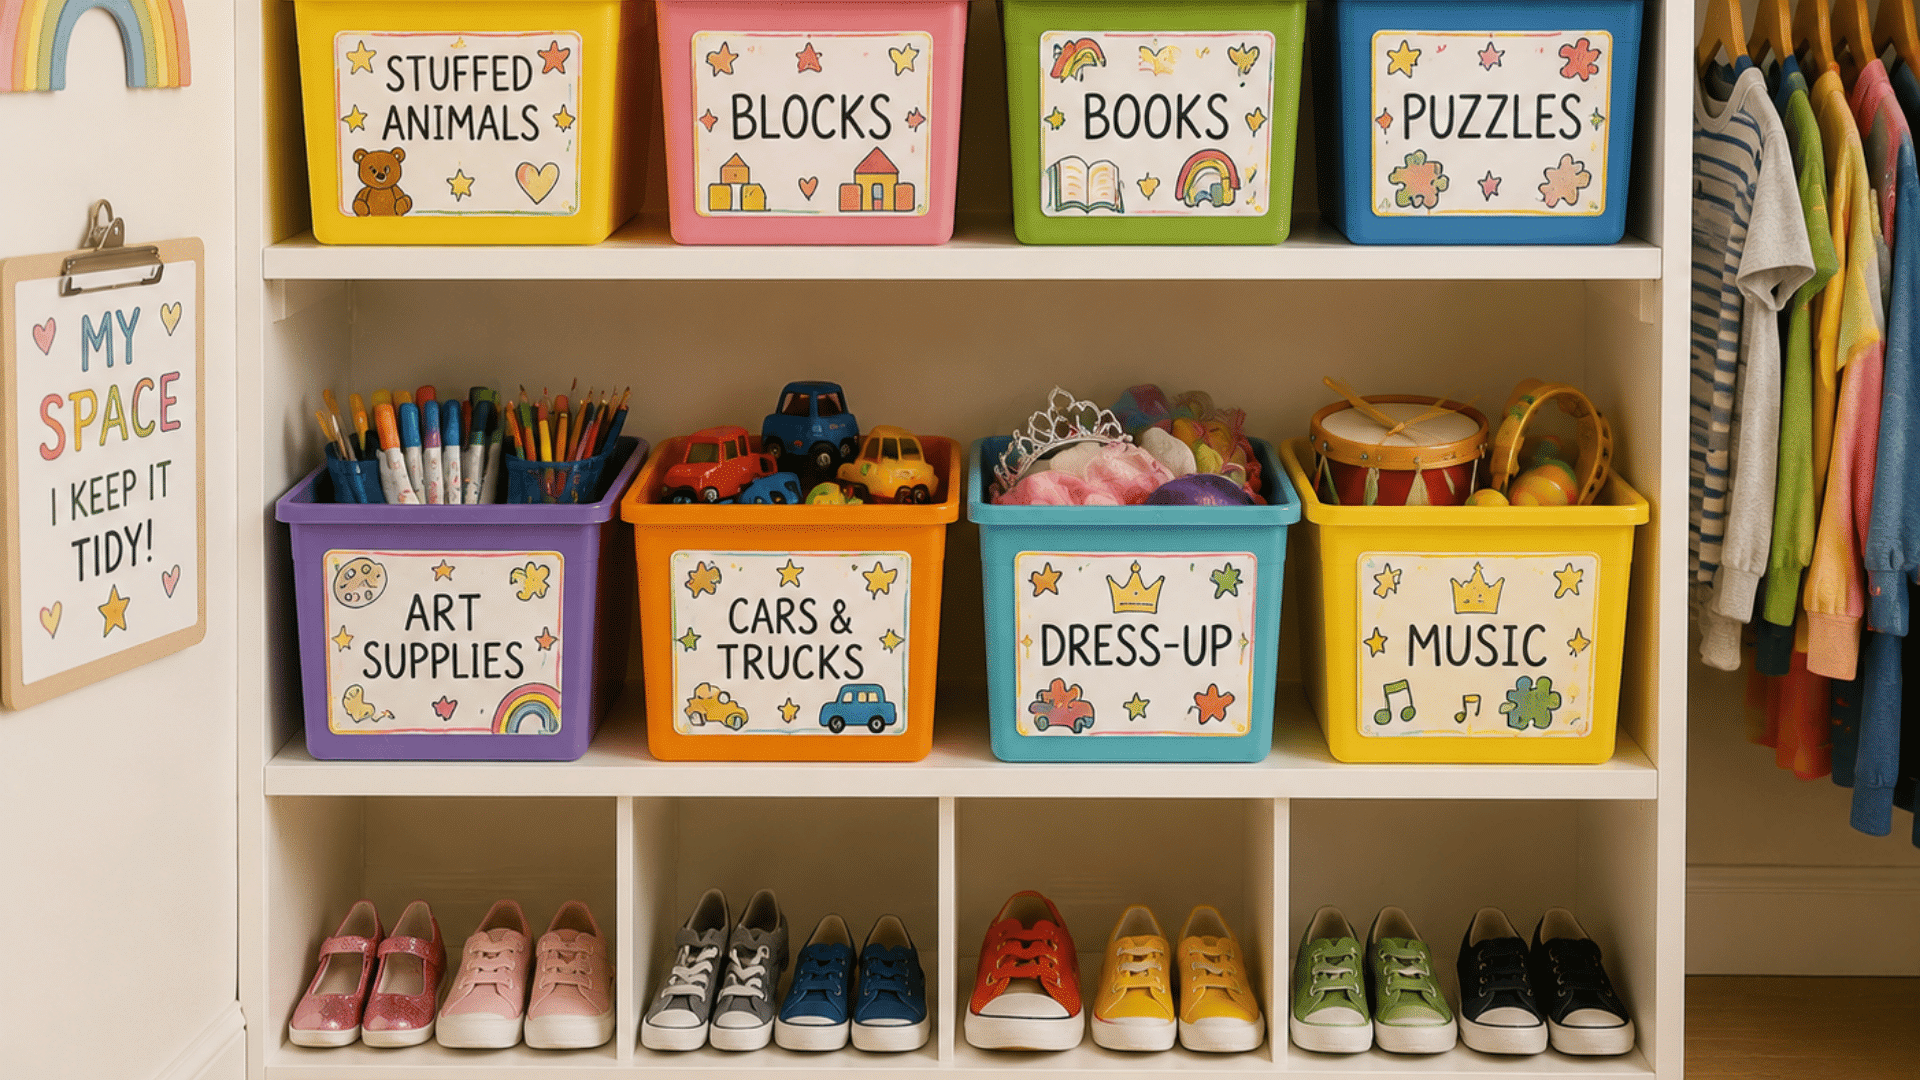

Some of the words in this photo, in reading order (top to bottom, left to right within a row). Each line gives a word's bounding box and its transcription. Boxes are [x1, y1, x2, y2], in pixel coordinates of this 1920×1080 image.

[386, 55, 533, 92] STUFFED
[381, 104, 540, 142] ANIMALS
[731, 93, 892, 141] BLOCKS
[1084, 92, 1229, 141] BOOKS
[1403, 93, 1582, 140] PUZZLES
[80, 306, 142, 372] MY
[39, 371, 182, 461] SPACE
[71, 469, 137, 520] KEEP
[149, 460, 172, 501] IT
[71, 518, 152, 582] TIDY!
[404, 593, 482, 632] ART
[728, 597, 818, 635] CARS
[829, 598, 853, 635] &
[362, 640, 524, 680] SUPPLIES
[716, 643, 864, 680] TRUCKS
[1041, 623, 1232, 667] DRESS-UP
[1408, 623, 1547, 668] MUSIC
